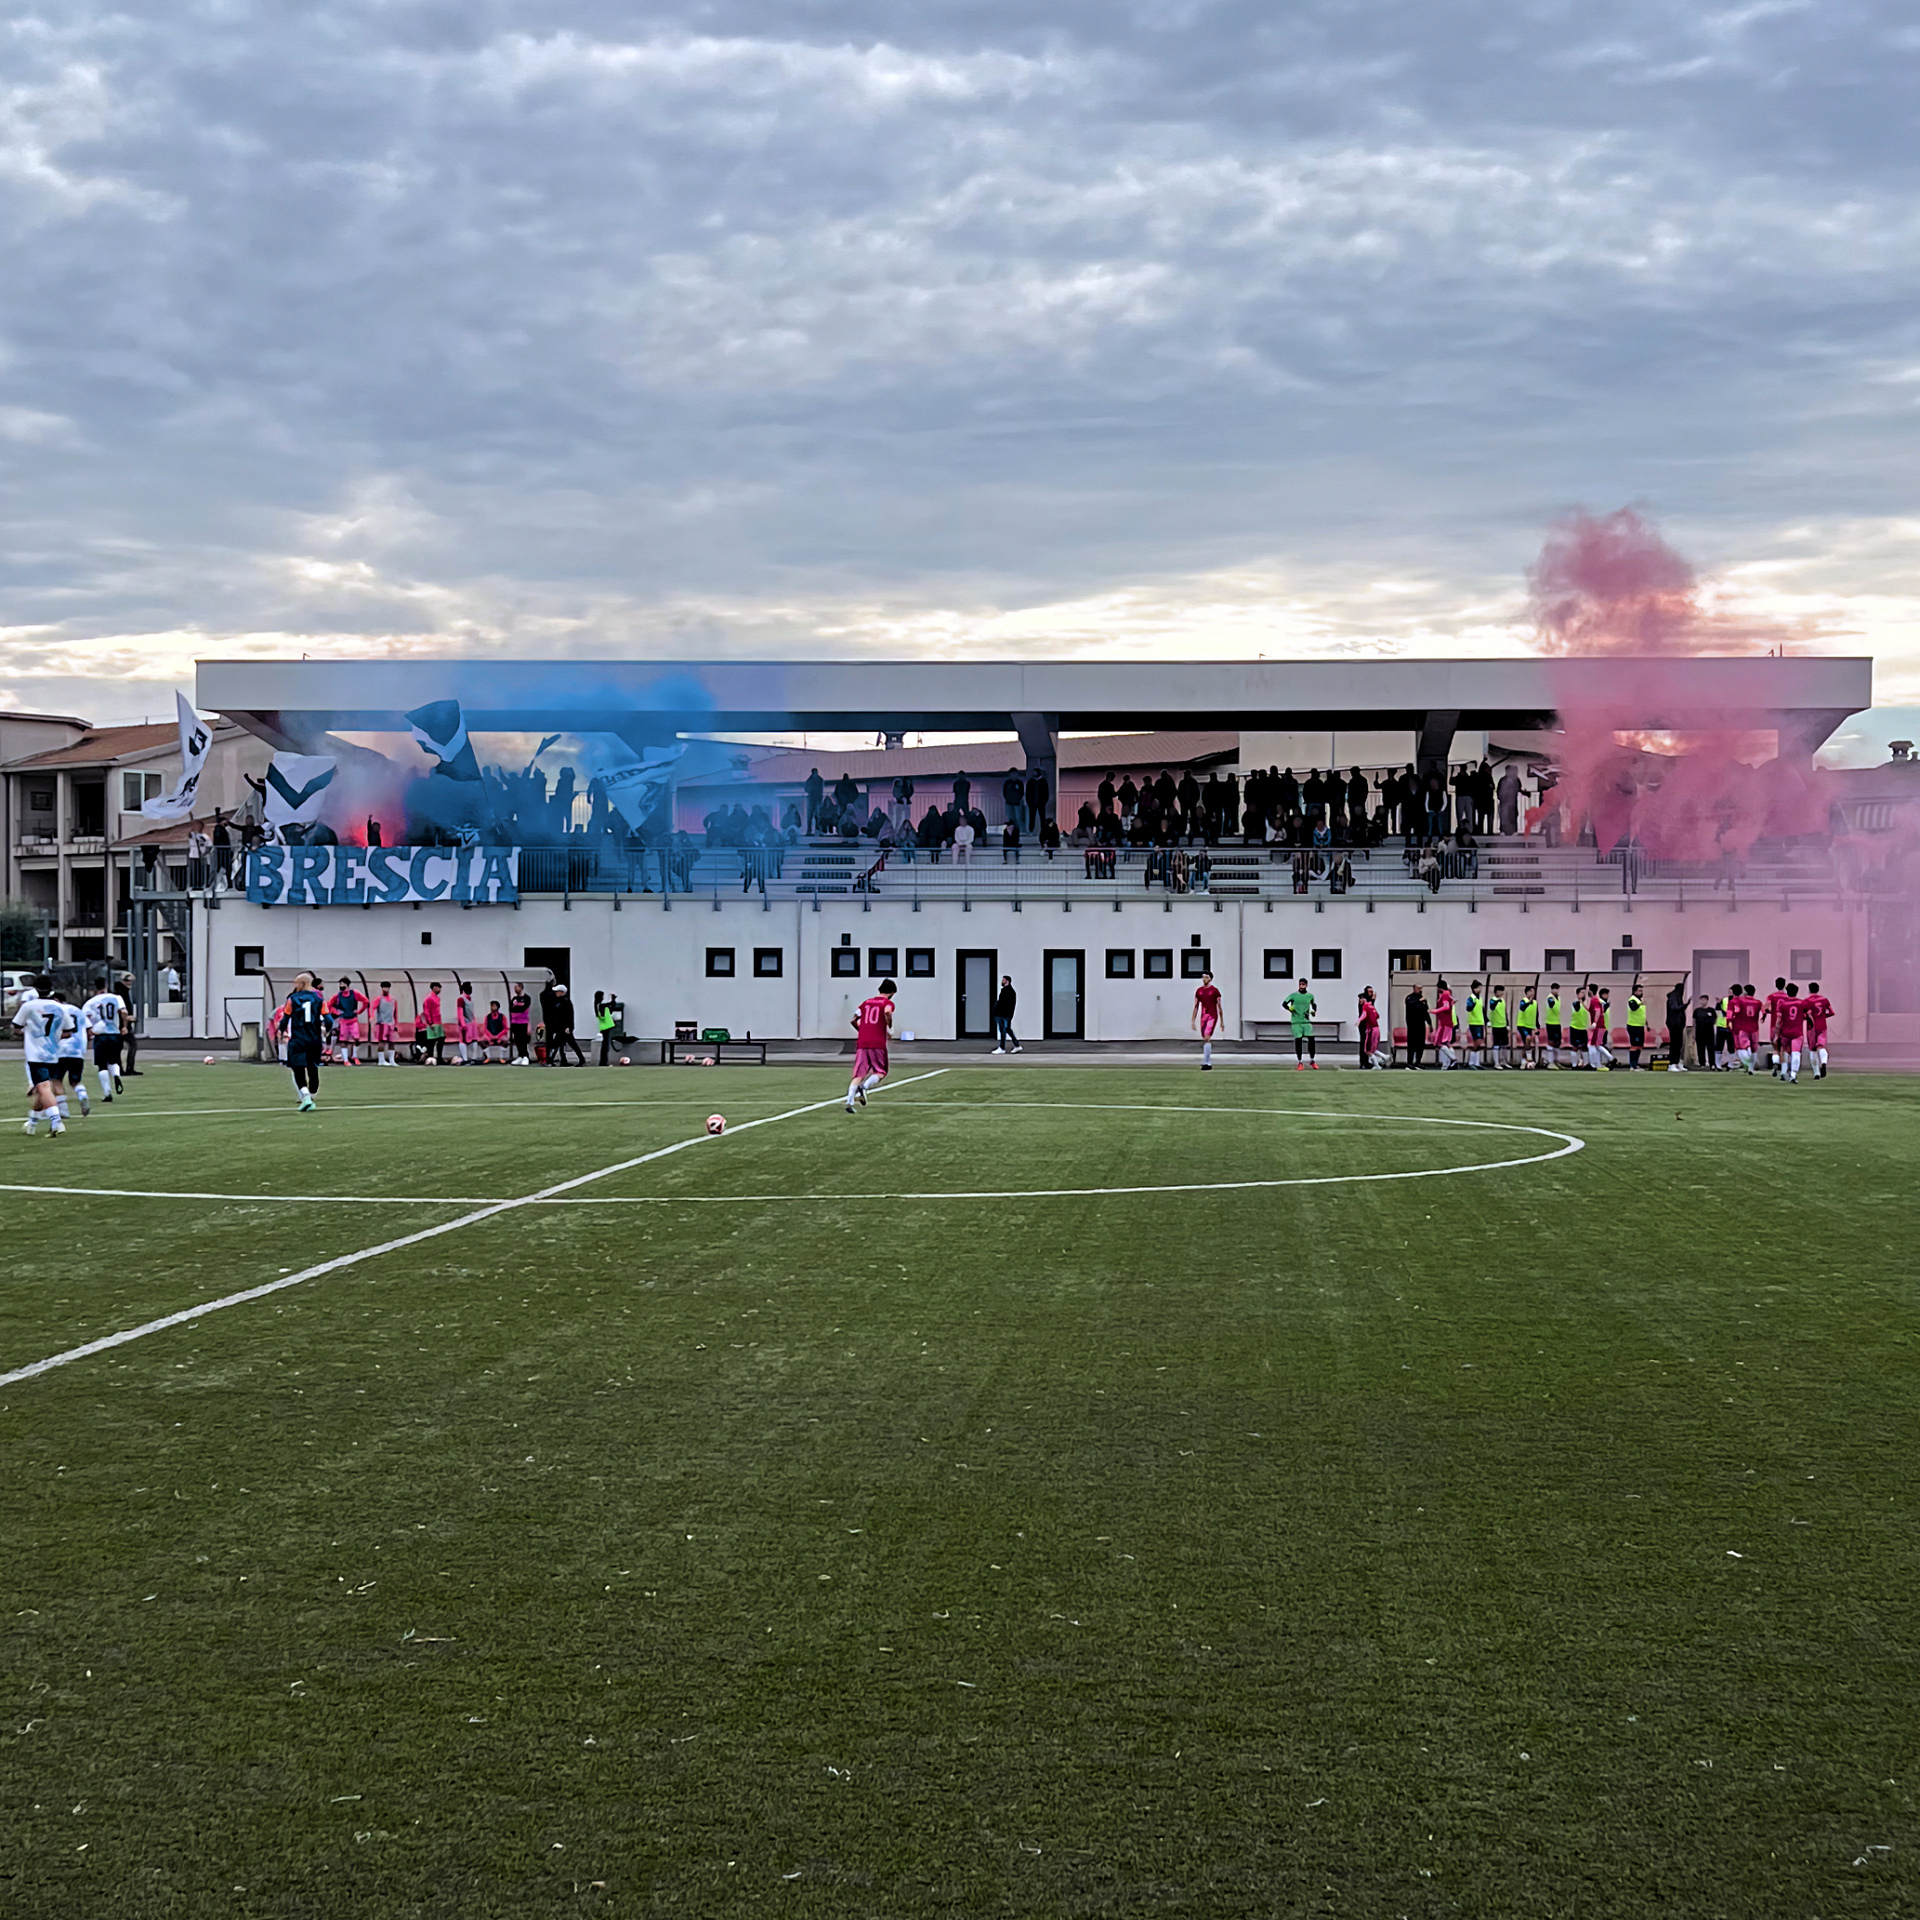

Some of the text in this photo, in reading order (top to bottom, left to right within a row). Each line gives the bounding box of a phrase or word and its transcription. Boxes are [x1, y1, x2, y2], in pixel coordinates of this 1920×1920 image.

[246, 845, 518, 906] BRESCIA
[98, 1003, 115, 1020] 10
[302, 1001, 312, 1023] 1
[864, 1004, 880, 1025] 10
[1789, 1006, 1798, 1021] 9
[41, 1013, 55, 1037] 7
